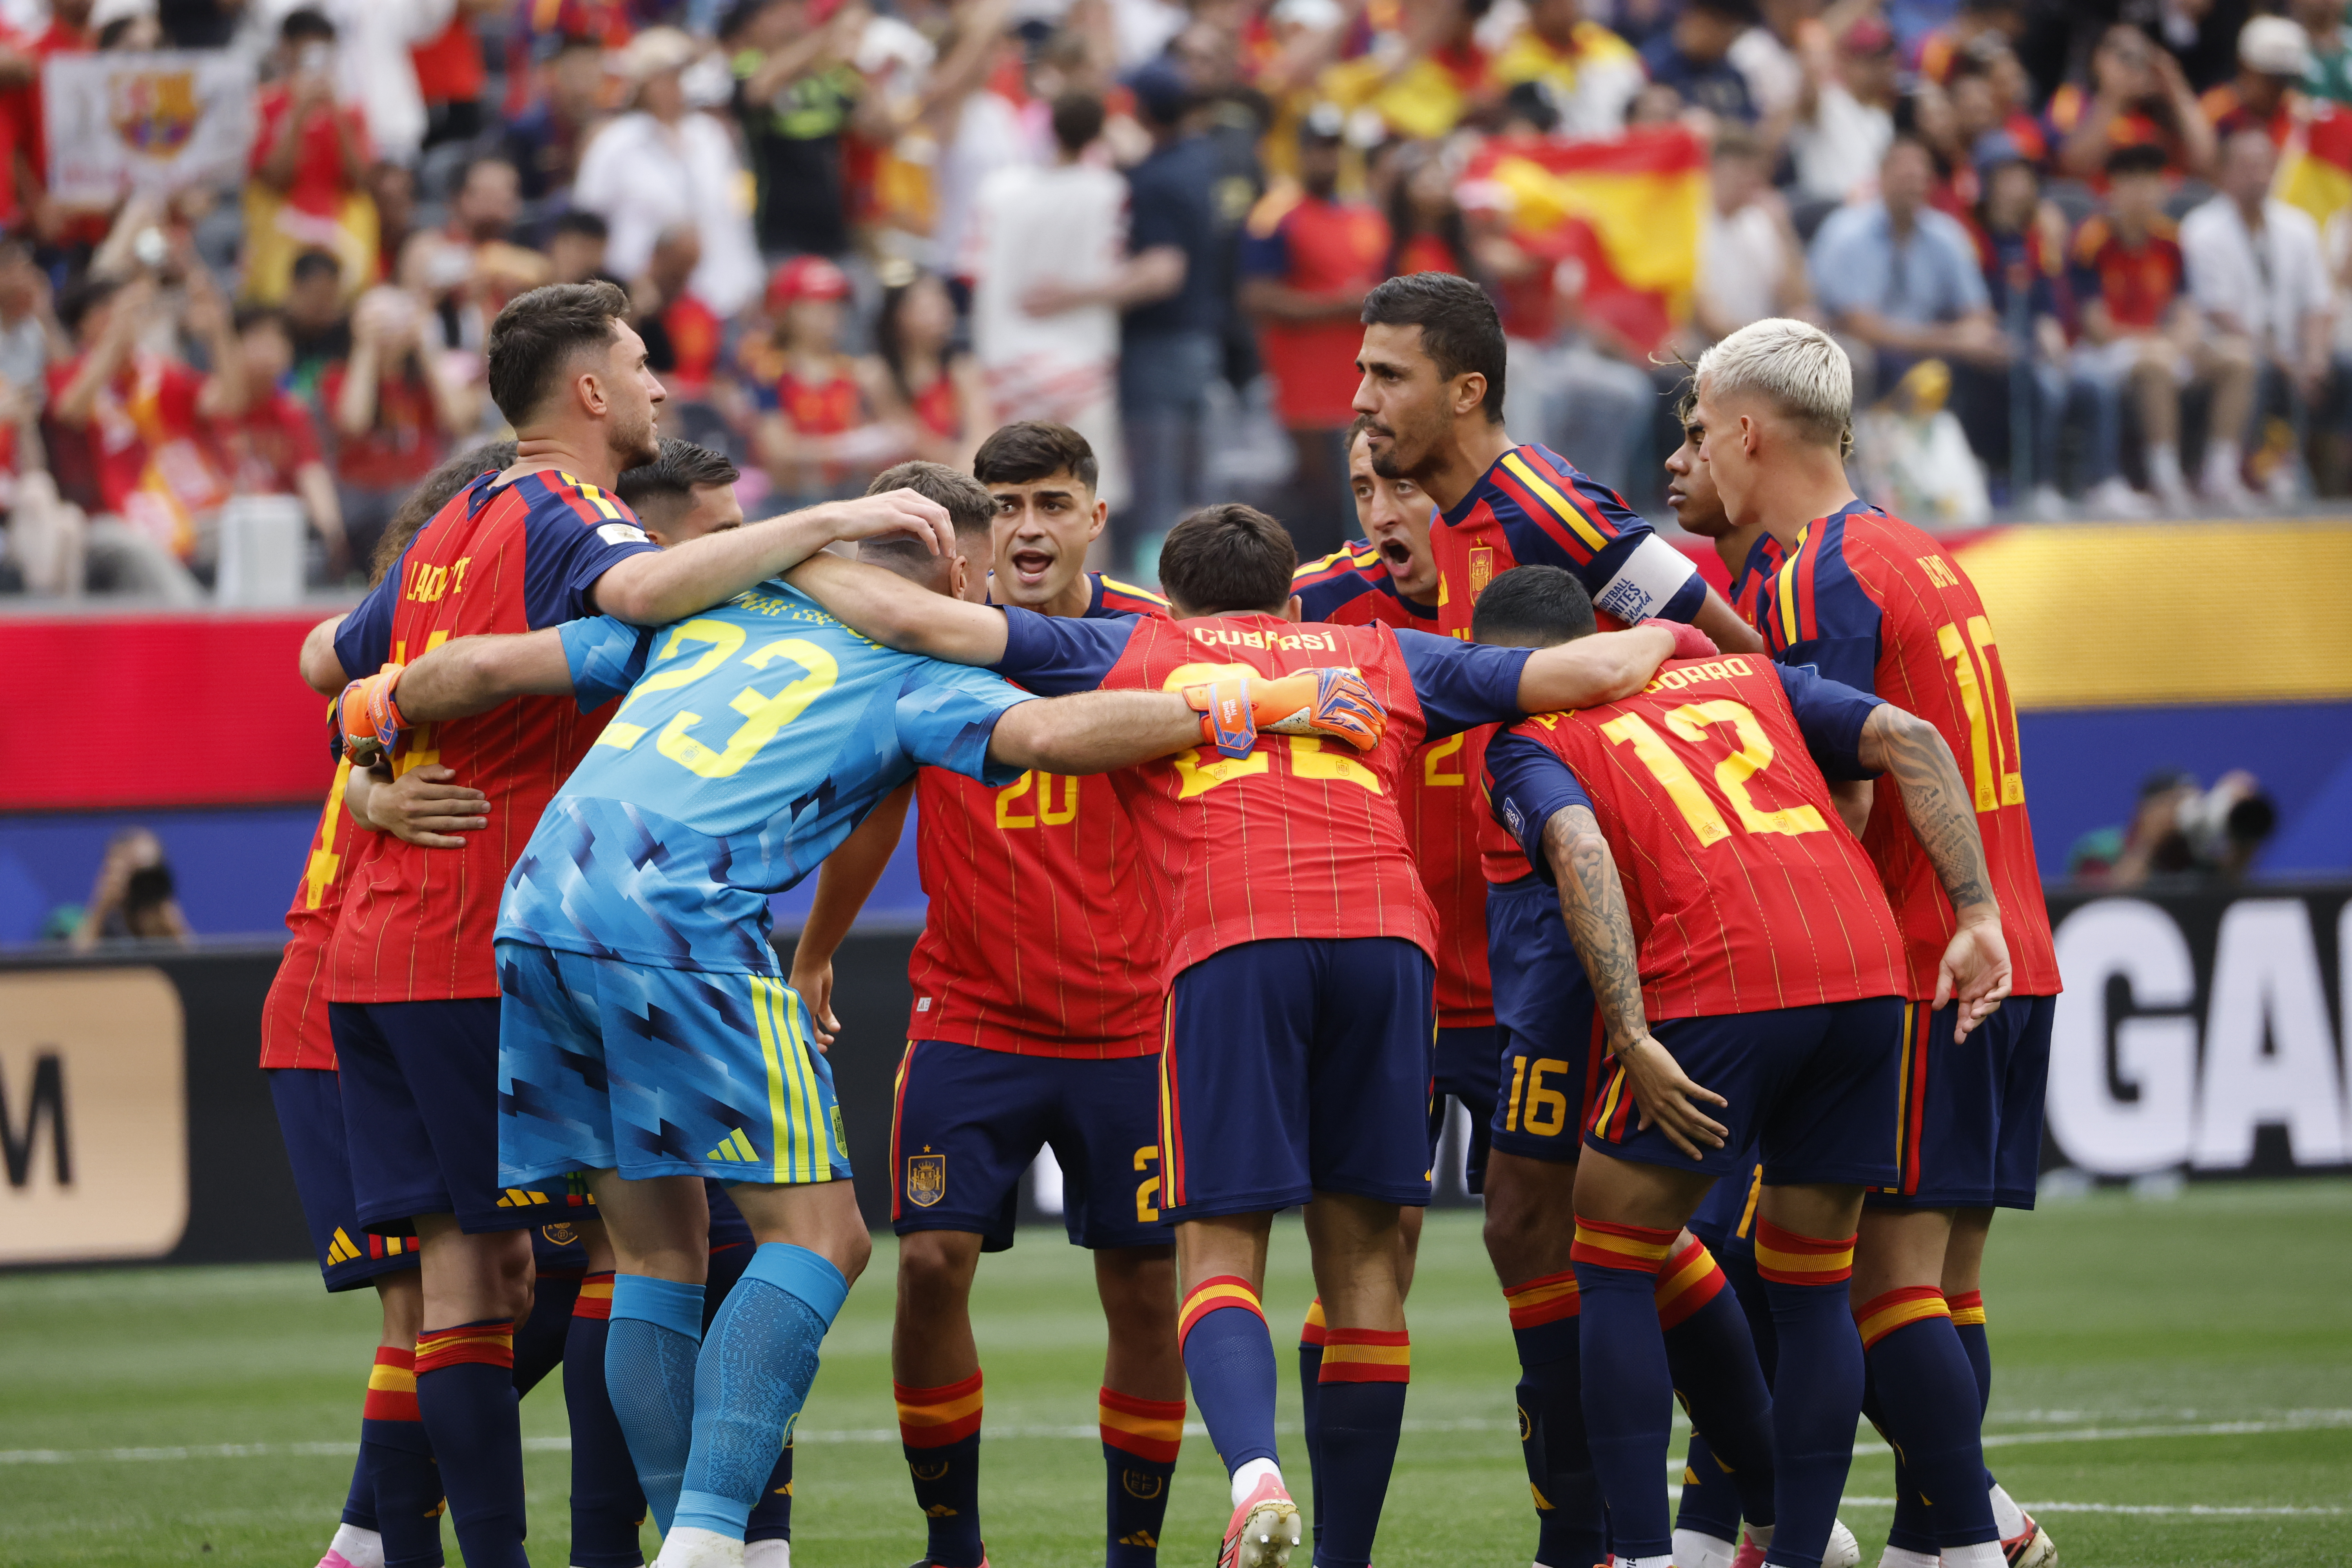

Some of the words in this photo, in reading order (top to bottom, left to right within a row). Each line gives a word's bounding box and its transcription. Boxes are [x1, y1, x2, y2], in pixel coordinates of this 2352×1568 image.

[1599, 578, 1631, 609] OOTBALL
[1625, 591, 1653, 619] World
[1194, 627, 1336, 652] CUBARSÍ
[373, 701, 381, 719] UNAI
[592, 619, 838, 778] 23
[1222, 701, 1232, 724] SIMON
[1229, 699, 1238, 715] UNAI
[1937, 615, 2025, 813] 10
[1599, 700, 1829, 848] 12
[996, 768, 1078, 829] 20
[2046, 897, 2352, 1175] GA
[1506, 1055, 1569, 1136] 16
